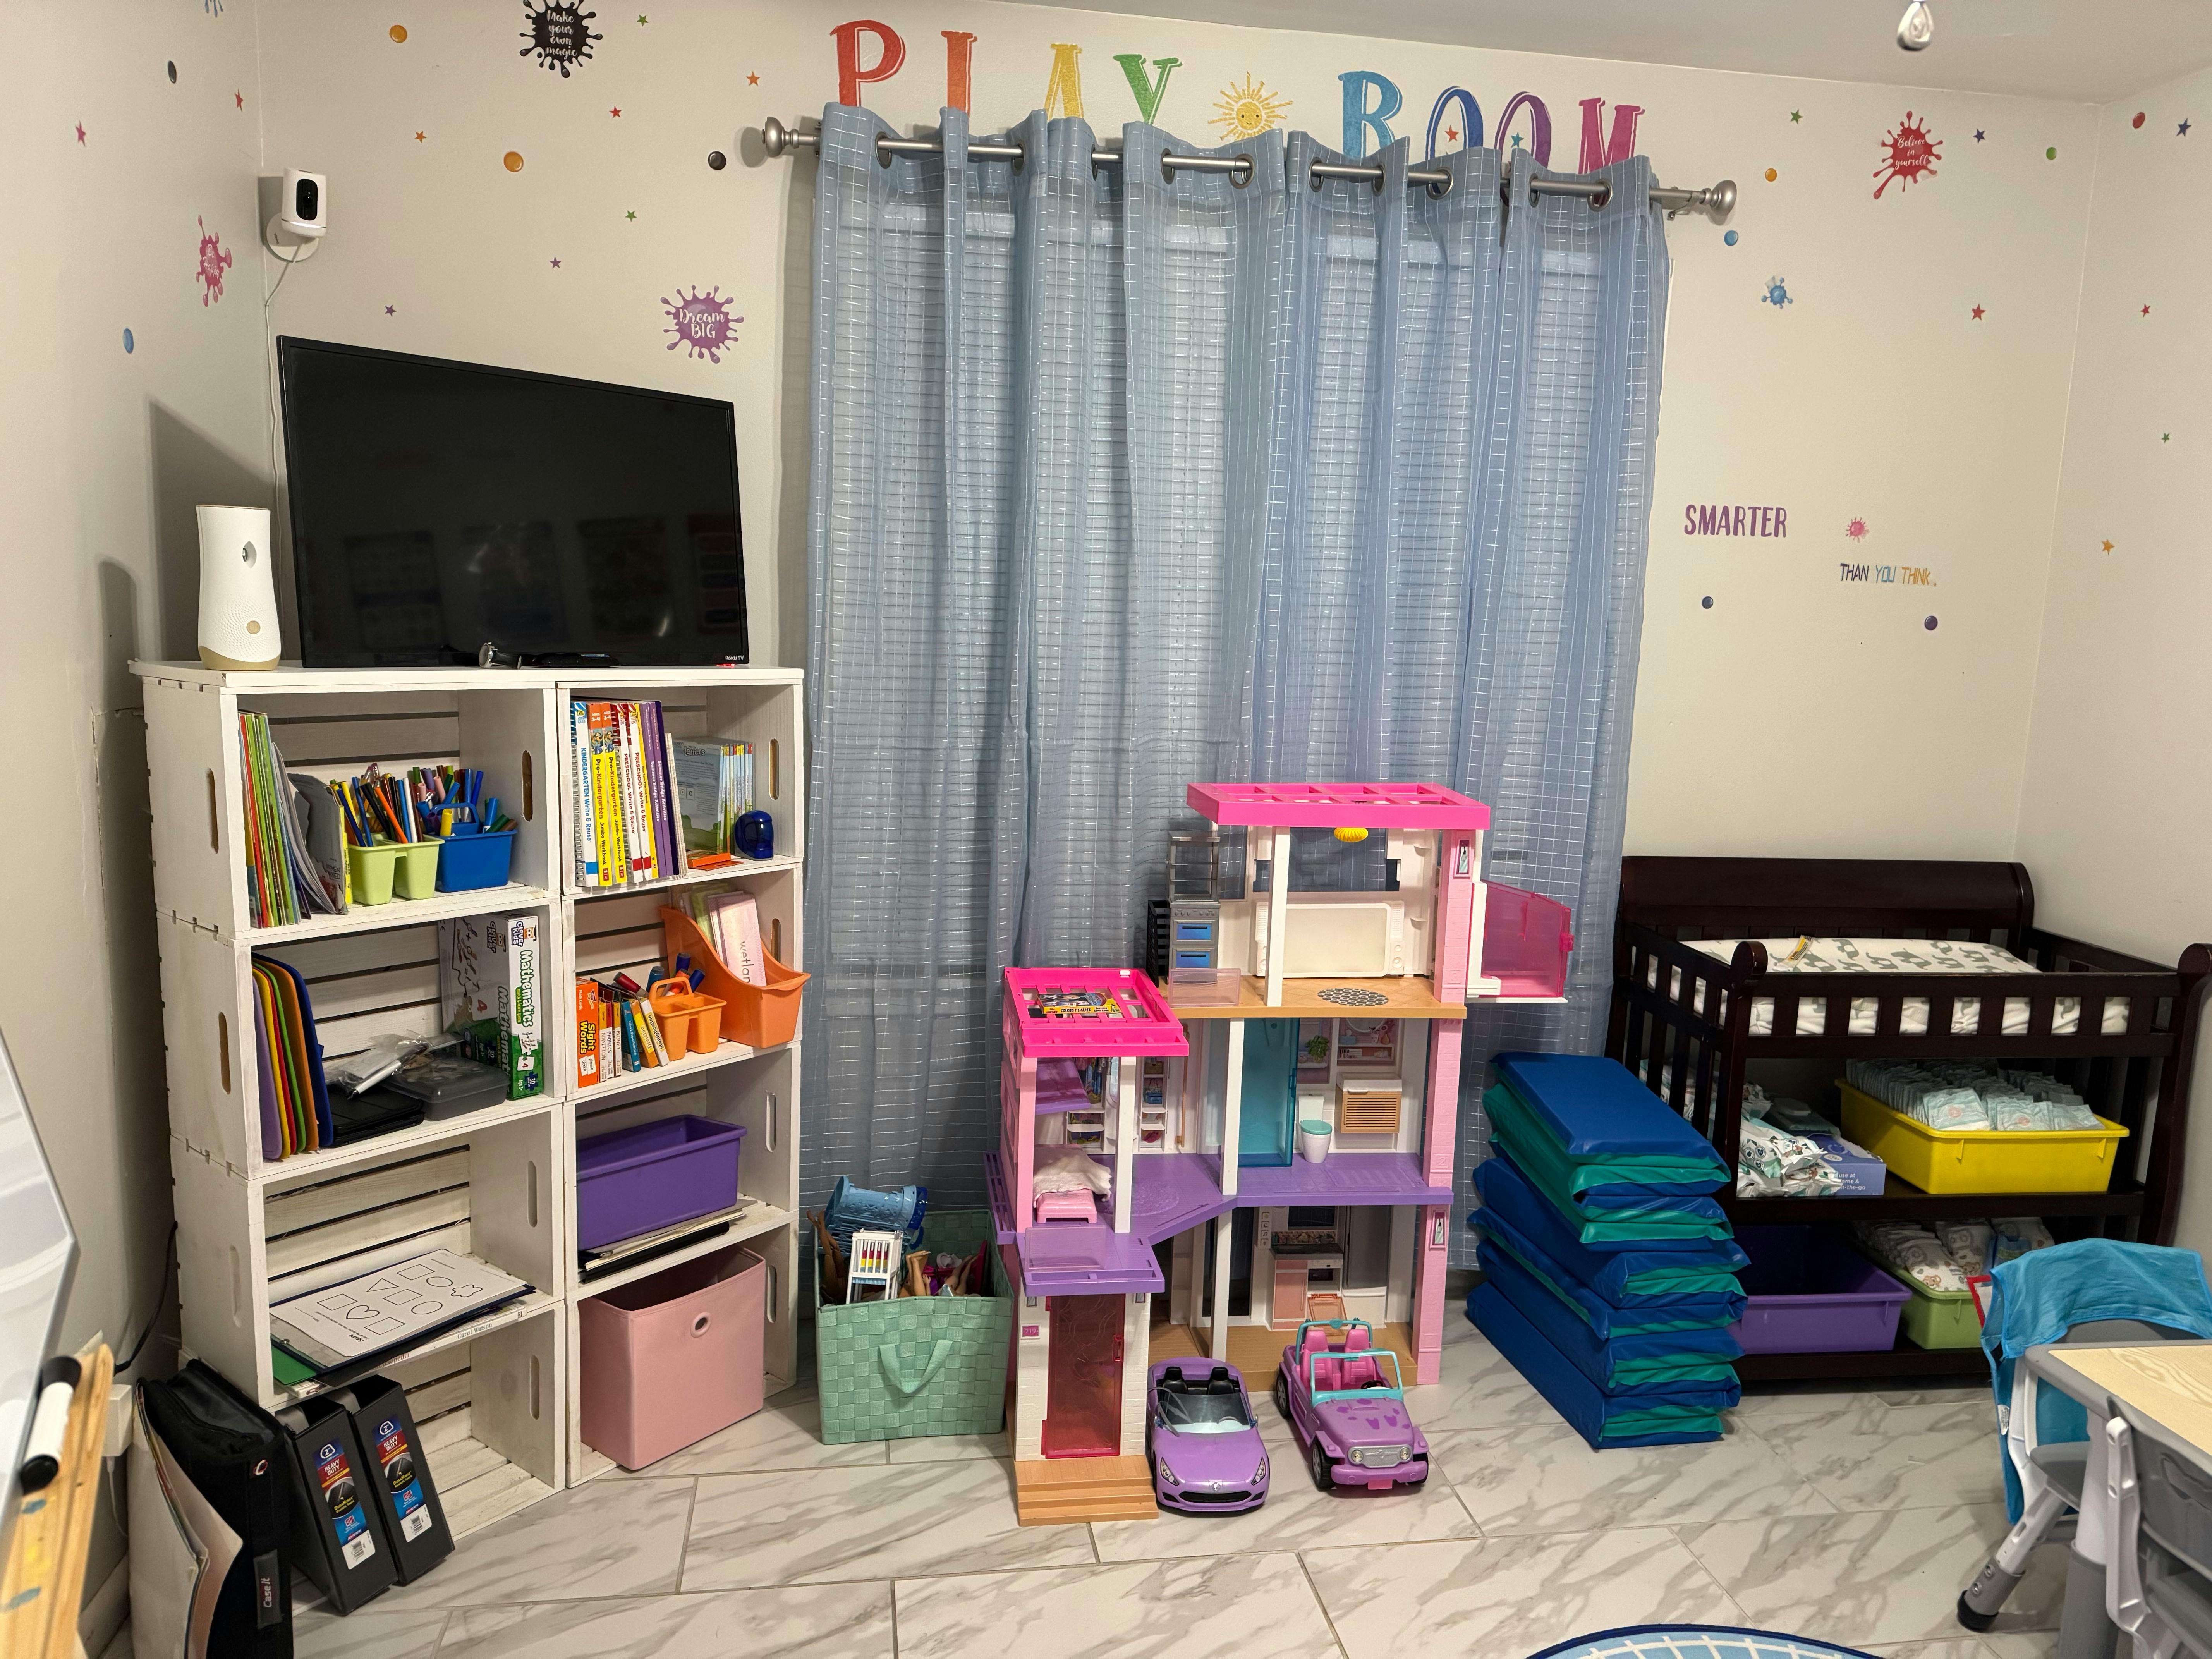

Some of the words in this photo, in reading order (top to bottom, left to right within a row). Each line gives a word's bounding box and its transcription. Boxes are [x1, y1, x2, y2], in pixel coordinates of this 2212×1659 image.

[547, 10, 574, 23] Make
[548, 25, 574, 36] your
[550, 36, 573, 45] own
[545, 46, 577, 60] magic
[1338, 70, 1645, 175] ROOM
[1897, 135, 1925, 148] Believe
[679, 309, 725, 323] Dream
[691, 323, 715, 338] BIG
[1684, 504, 1786, 538] SMARTER
[1840, 563, 1869, 581] THAN
[1875, 565, 1896, 583] YOU
[684, 746, 706, 757] letters
[581, 748, 589, 797] KINDERGARTEN
[609, 757, 617, 816] Pre-Kindergarten
[520, 950, 534, 1028] Mathematics
[641, 1026, 652, 1049] Division
[648, 1015, 664, 1049] Multiplication
[457, 1330, 472, 1339] Carol
[474, 1323, 492, 1333] Watson
[383, 1435, 398, 1448] HEAVY
[386, 1441, 398, 1451] DUTY
[325, 1459, 340, 1472] HEAVY
[327, 1465, 340, 1476] DUTY
[263, 1585, 271, 1608] Case
